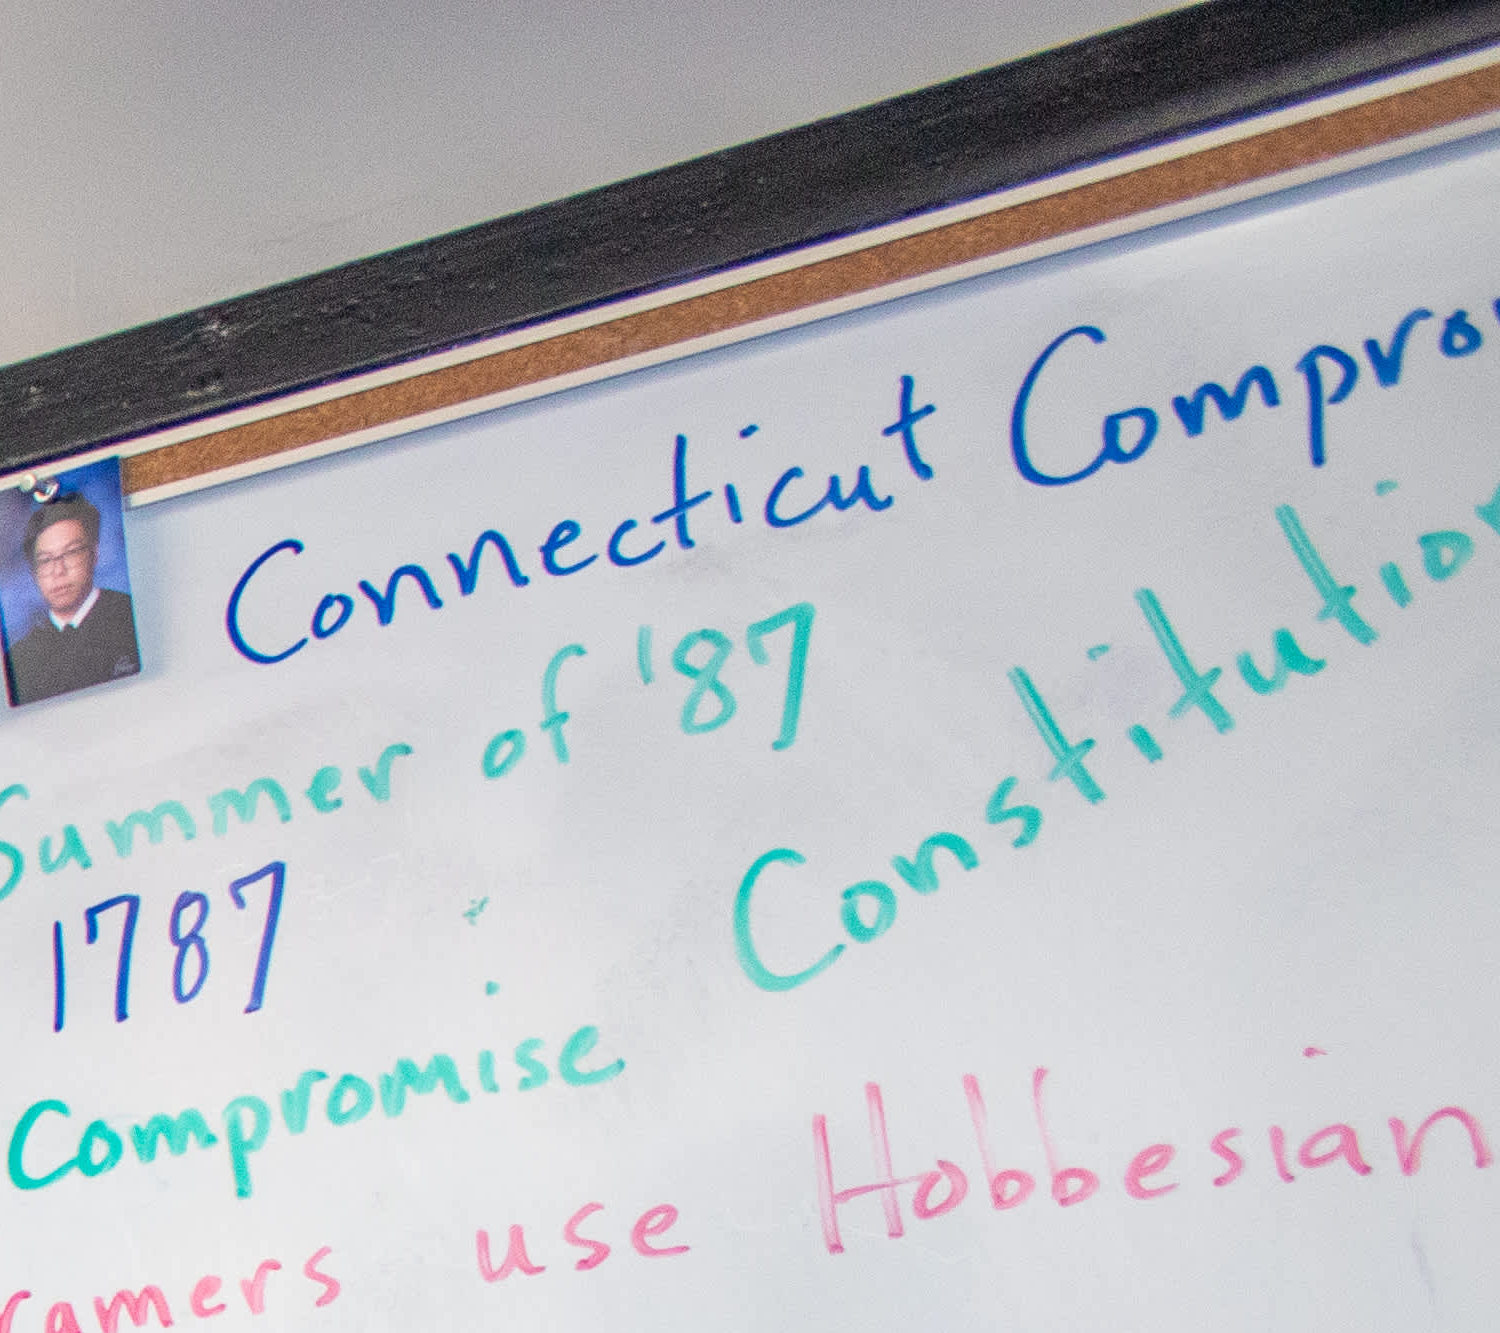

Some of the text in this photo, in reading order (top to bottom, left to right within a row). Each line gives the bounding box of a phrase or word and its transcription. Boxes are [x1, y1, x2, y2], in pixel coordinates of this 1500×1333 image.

[223, 298, 1500, 666] Connecticut Compro
[481, 642, 588, 782] of
[636, 600, 818, 752] '87
[46, 859, 289, 1035] 1787
[6, 980, 627, 1200] Compromise
[474, 1203, 692, 1285] use
[813, 1046, 1496, 1256] Hobbesian
